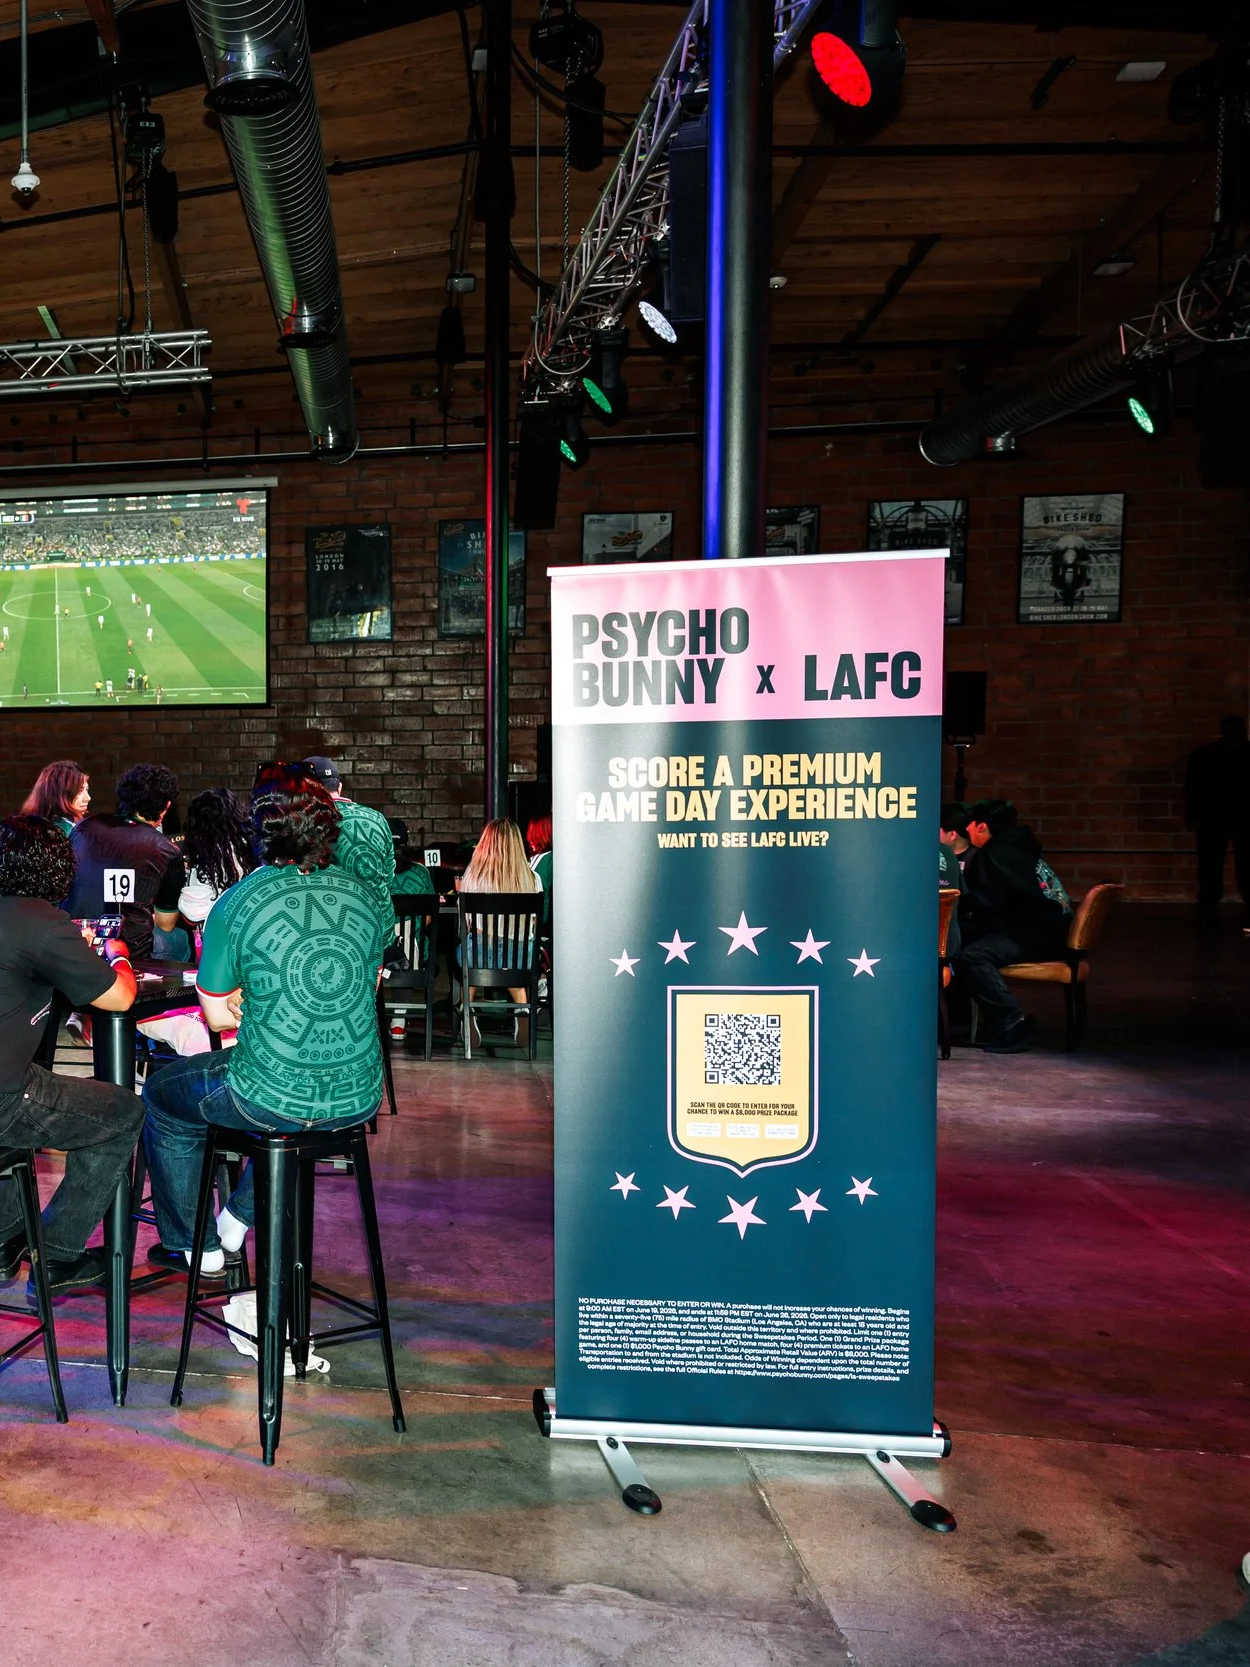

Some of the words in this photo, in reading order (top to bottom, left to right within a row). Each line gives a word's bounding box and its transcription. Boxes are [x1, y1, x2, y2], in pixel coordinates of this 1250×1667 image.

[1042, 513, 1069, 524] BIKE
[1073, 513, 1102, 523] SHED
[572, 607, 749, 660] PSYCHO
[572, 658, 725, 708] BUNNY
[756, 664, 775, 694] x
[804, 651, 922, 701] LAFC
[608, 756, 704, 788] SCORE
[713, 755, 734, 786] A
[743, 752, 881, 786] PREMIUM
[576, 790, 657, 823] GAME
[666, 790, 721, 822] DAY
[730, 787, 917, 821] EXPERIENCE
[657, 833, 696, 848] WANT
[701, 833, 718, 848] TO
[722, 832, 747, 847] SEE
[751, 832, 786, 847] LAFC
[789, 831, 829, 847] LIVE?
[427, 852, 437, 863] 10
[109, 874, 130, 896] 19
[754, 1333, 795, 1341] Sweepstakes
[579, 1349, 623, 1357] Transportation
